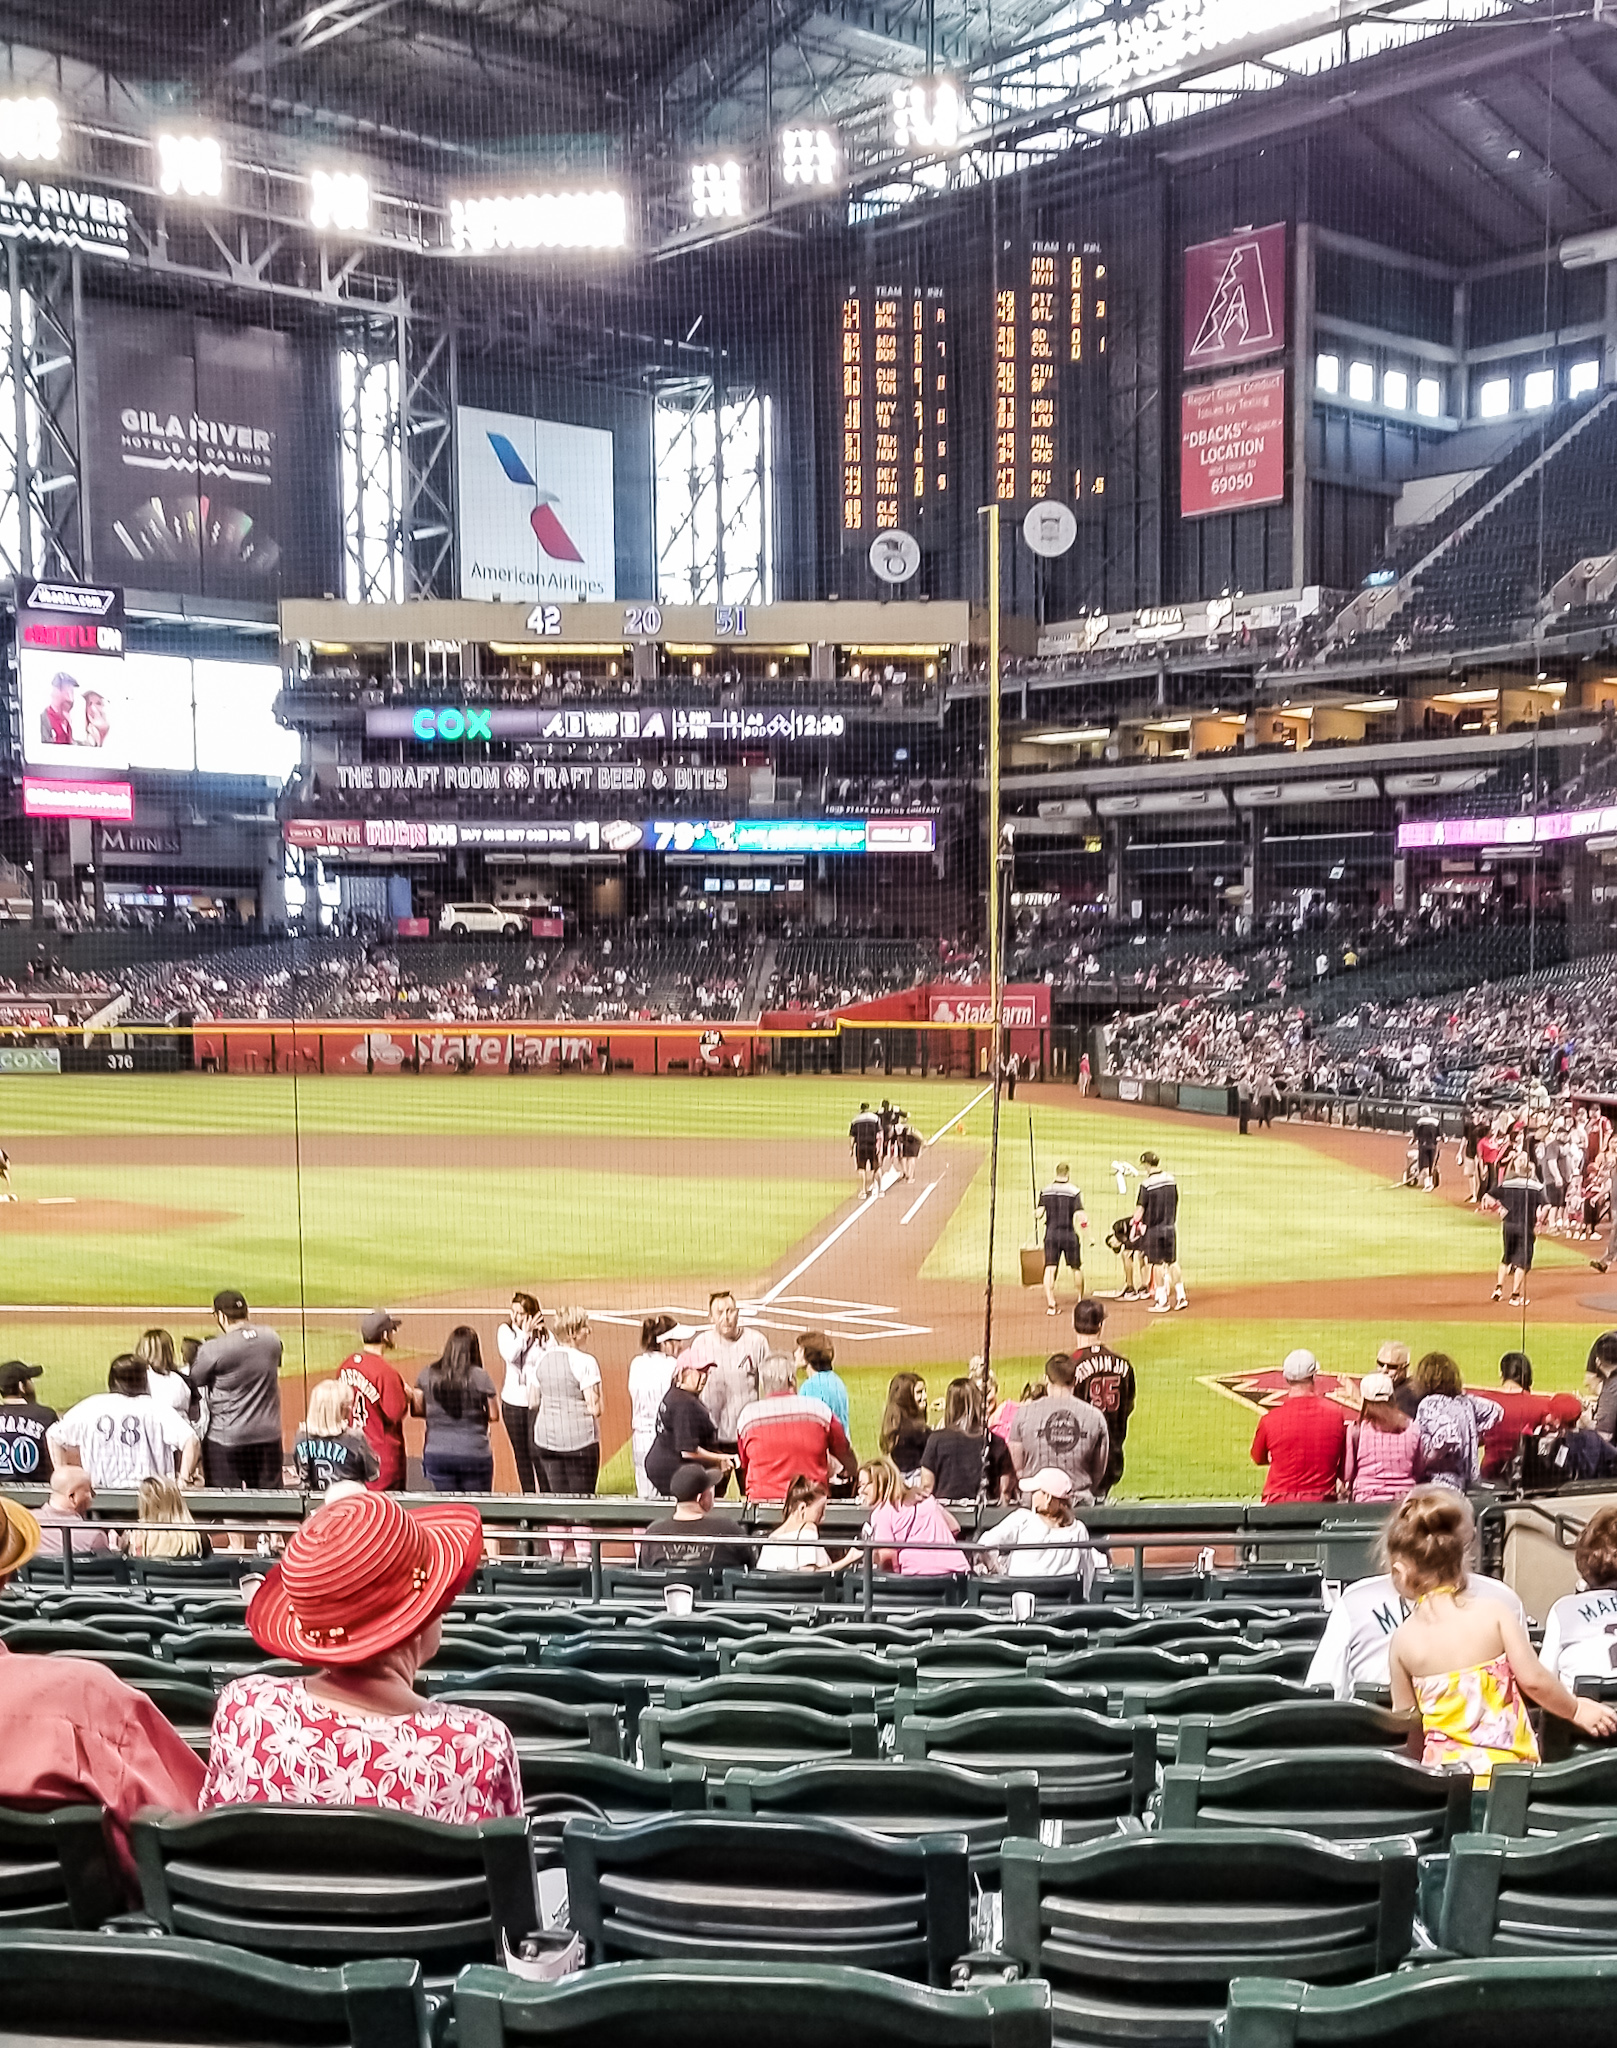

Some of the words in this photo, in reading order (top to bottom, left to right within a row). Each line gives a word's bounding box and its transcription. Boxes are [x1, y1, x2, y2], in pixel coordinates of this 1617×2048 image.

[39, 183, 128, 227] RIVER
[55, 214, 129, 242] CASINOS
[1031, 291, 1055, 307] PIT
[1031, 342, 1054, 357] COL
[1031, 363, 1055, 379] CIN
[121, 407, 187, 442] GILA
[188, 412, 271, 452] RIVER
[1031, 434, 1055, 449] MIL
[121, 434, 182, 455] HOTELS
[205, 446, 272, 470] CASINOS
[1200, 436, 1265, 467] LOCATION
[1211, 471, 1254, 496] 69050
[471, 561, 545, 588] American
[546, 573, 605, 594] Airlines
[527, 605, 562, 636] 42
[623, 605, 662, 635] 20
[715, 605, 748, 637] 51
[413, 708, 493, 741] COX
[336, 766, 374, 789] THE
[378, 766, 440, 791] DRAFT
[444, 766, 500, 789] ROOM
[597, 766, 646, 790] BEER
[674, 767, 728, 791] BITES
[0, 1053, 44, 1069] COX
[411, 1033, 502, 1066] State
[96, 1414, 142, 1448] 98
[296, 1440, 348, 1464] PERALTA
